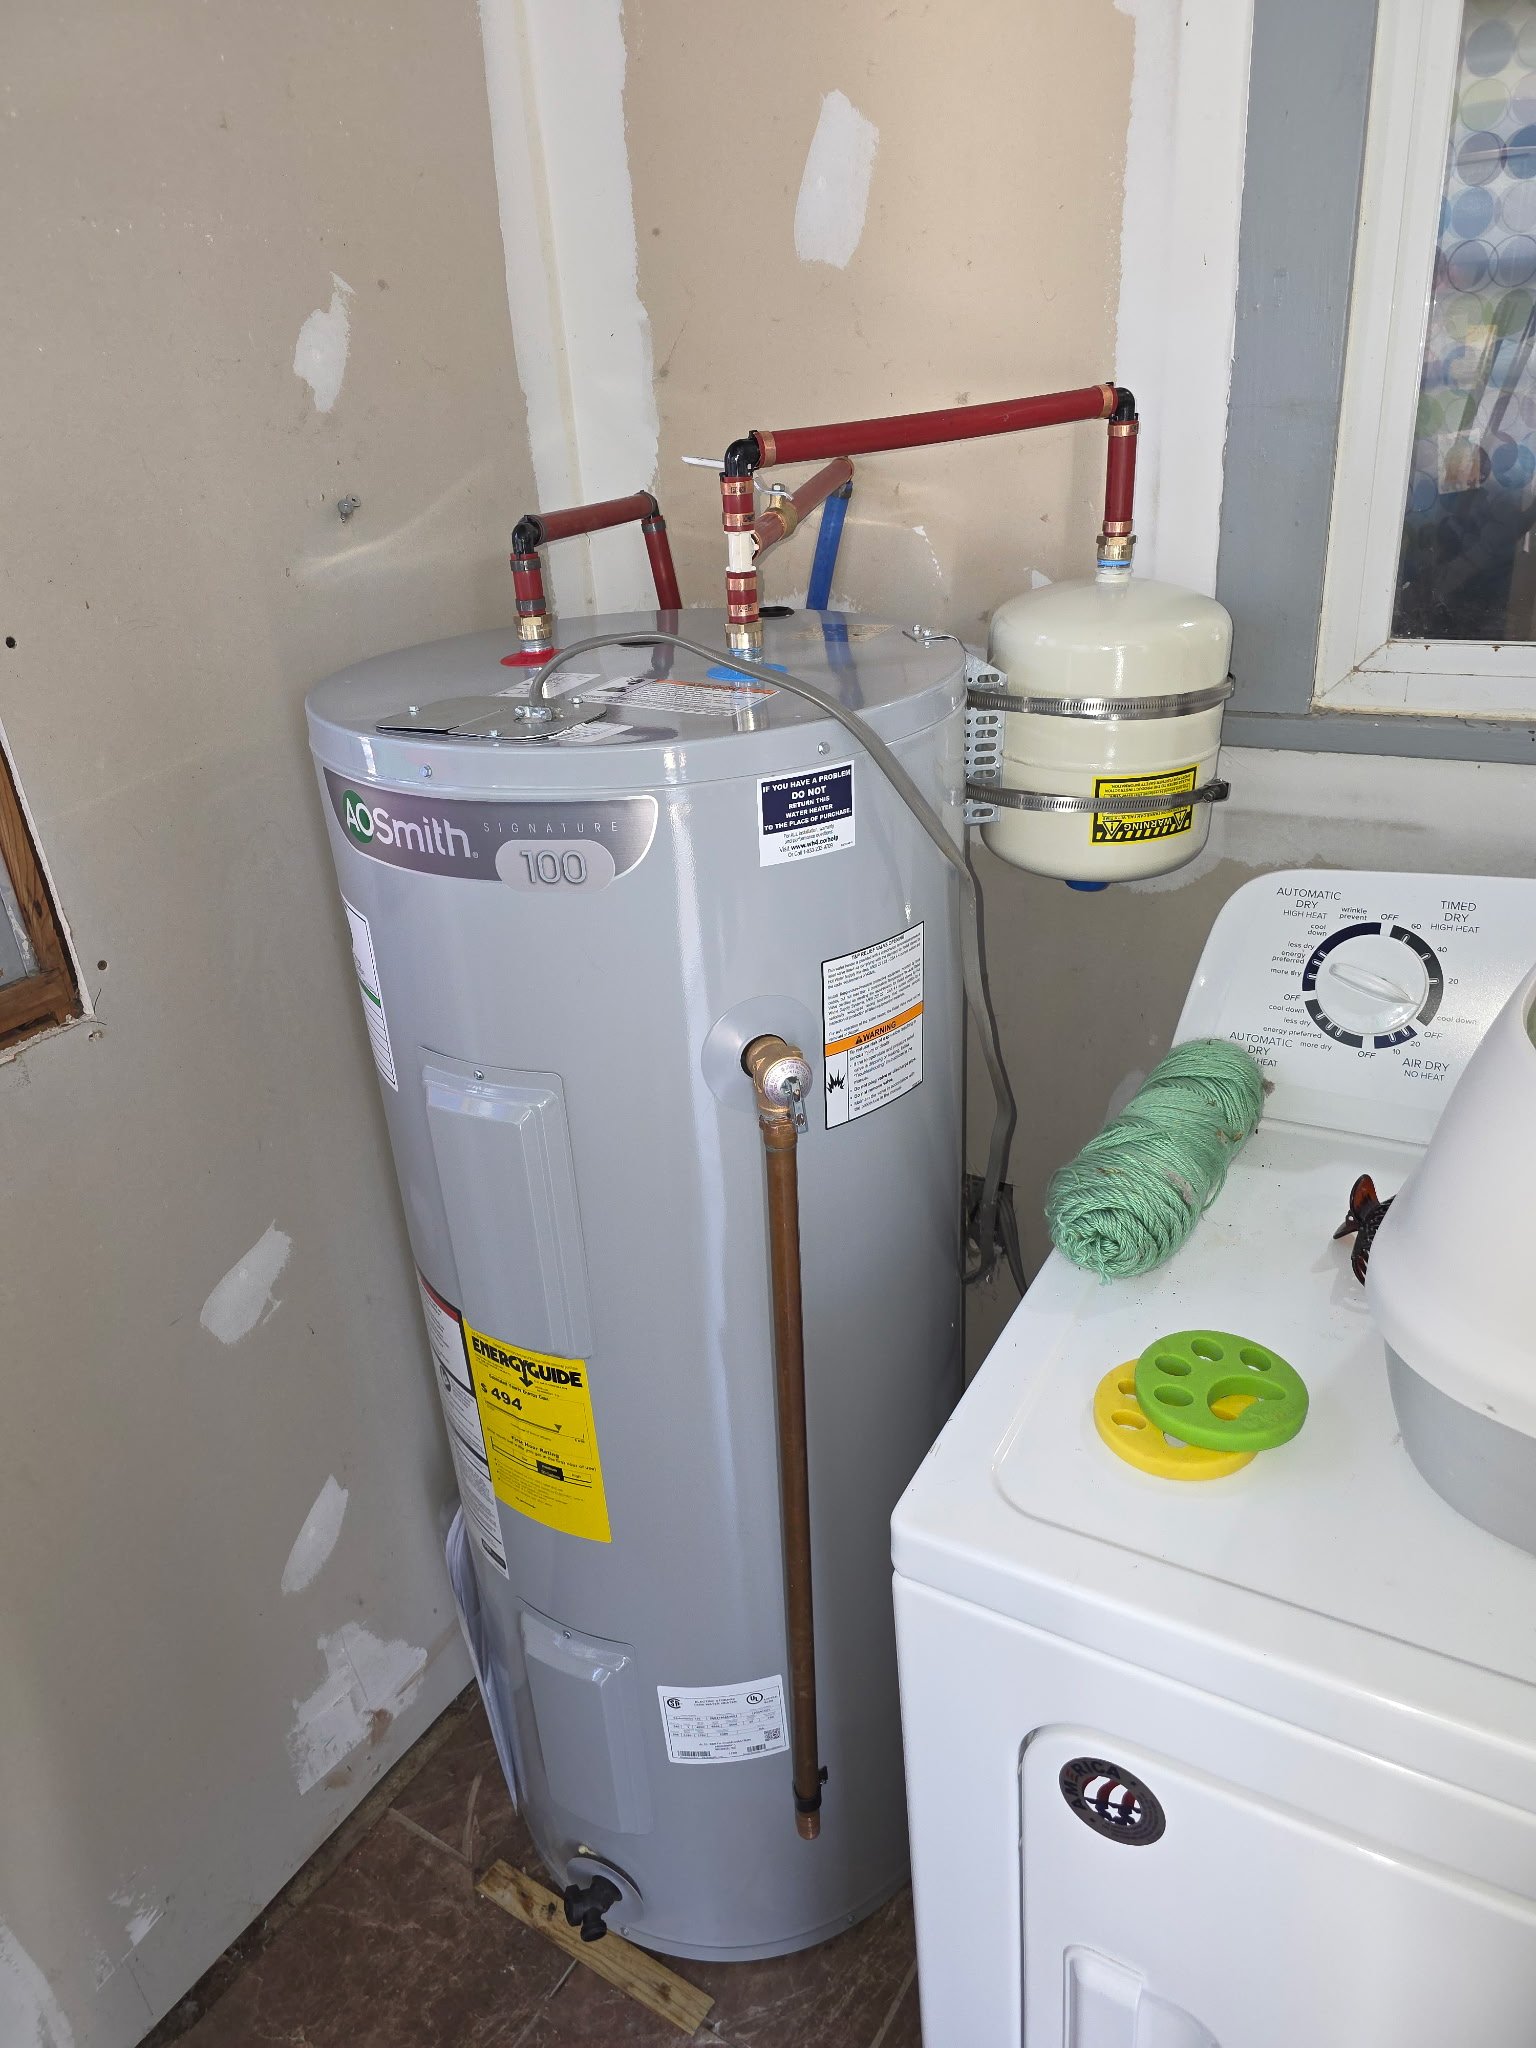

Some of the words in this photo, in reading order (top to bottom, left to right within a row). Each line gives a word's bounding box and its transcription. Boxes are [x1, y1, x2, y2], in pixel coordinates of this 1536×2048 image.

[772, 783, 788, 792] YOU
[790, 779, 810, 788] HAVE
[818, 769, 851, 783] PROBLEM
[792, 790, 805, 800] DO
[807, 785, 827, 797] NOT
[788, 800, 814, 810] RETURN
[816, 796, 830, 804] THIS
[786, 810, 808, 818] WATER
[809, 804, 833, 814] HEATER
[789, 818, 810, 827] PLACE
[820, 808, 852, 820] PURCHASE.
[1124, 817, 1172, 830] WARNING
[483, 821, 618, 833] SIGNATURE
[521, 850, 587, 884] 100
[1276, 888, 1342, 900] AUTOMATIC
[1296, 900, 1318, 909] DRY
[1441, 900, 1476, 912] TIMED
[1284, 910, 1304, 918] HIGH
[1306, 912, 1328, 920] HEAT
[1444, 912, 1469, 922] DRY
[1430, 923, 1454, 932] HIGH
[1456, 925, 1480, 934] HEAT
[1304, 942, 1314, 950] dry
[1272, 956, 1304, 964] preferred
[1284, 994, 1300, 1002] OFF
[1286, 1006, 1304, 1014] down
[862, 1020, 896, 1042] WARNING
[1263, 1026, 1287, 1035] energy
[1288, 1030, 1322, 1038] preferred
[1230, 1032, 1294, 1048] AUTOMATIC
[1248, 1044, 1270, 1056] DRY
[1320, 1044, 1332, 1052] dry
[1358, 1050, 1376, 1058] OFF
[1256, 1059, 1278, 1068] HEAT
[1402, 1058, 1422, 1068] AIR
[1425, 1060, 1450, 1072] DRY
[1404, 1070, 1418, 1078] NO
[1420, 1072, 1444, 1082] HEAT
[472, 1336, 583, 1388] ENERGYGUIDE
[490, 1388, 522, 1410] 494
[1063, 1759, 1121, 1811] AMERICA
